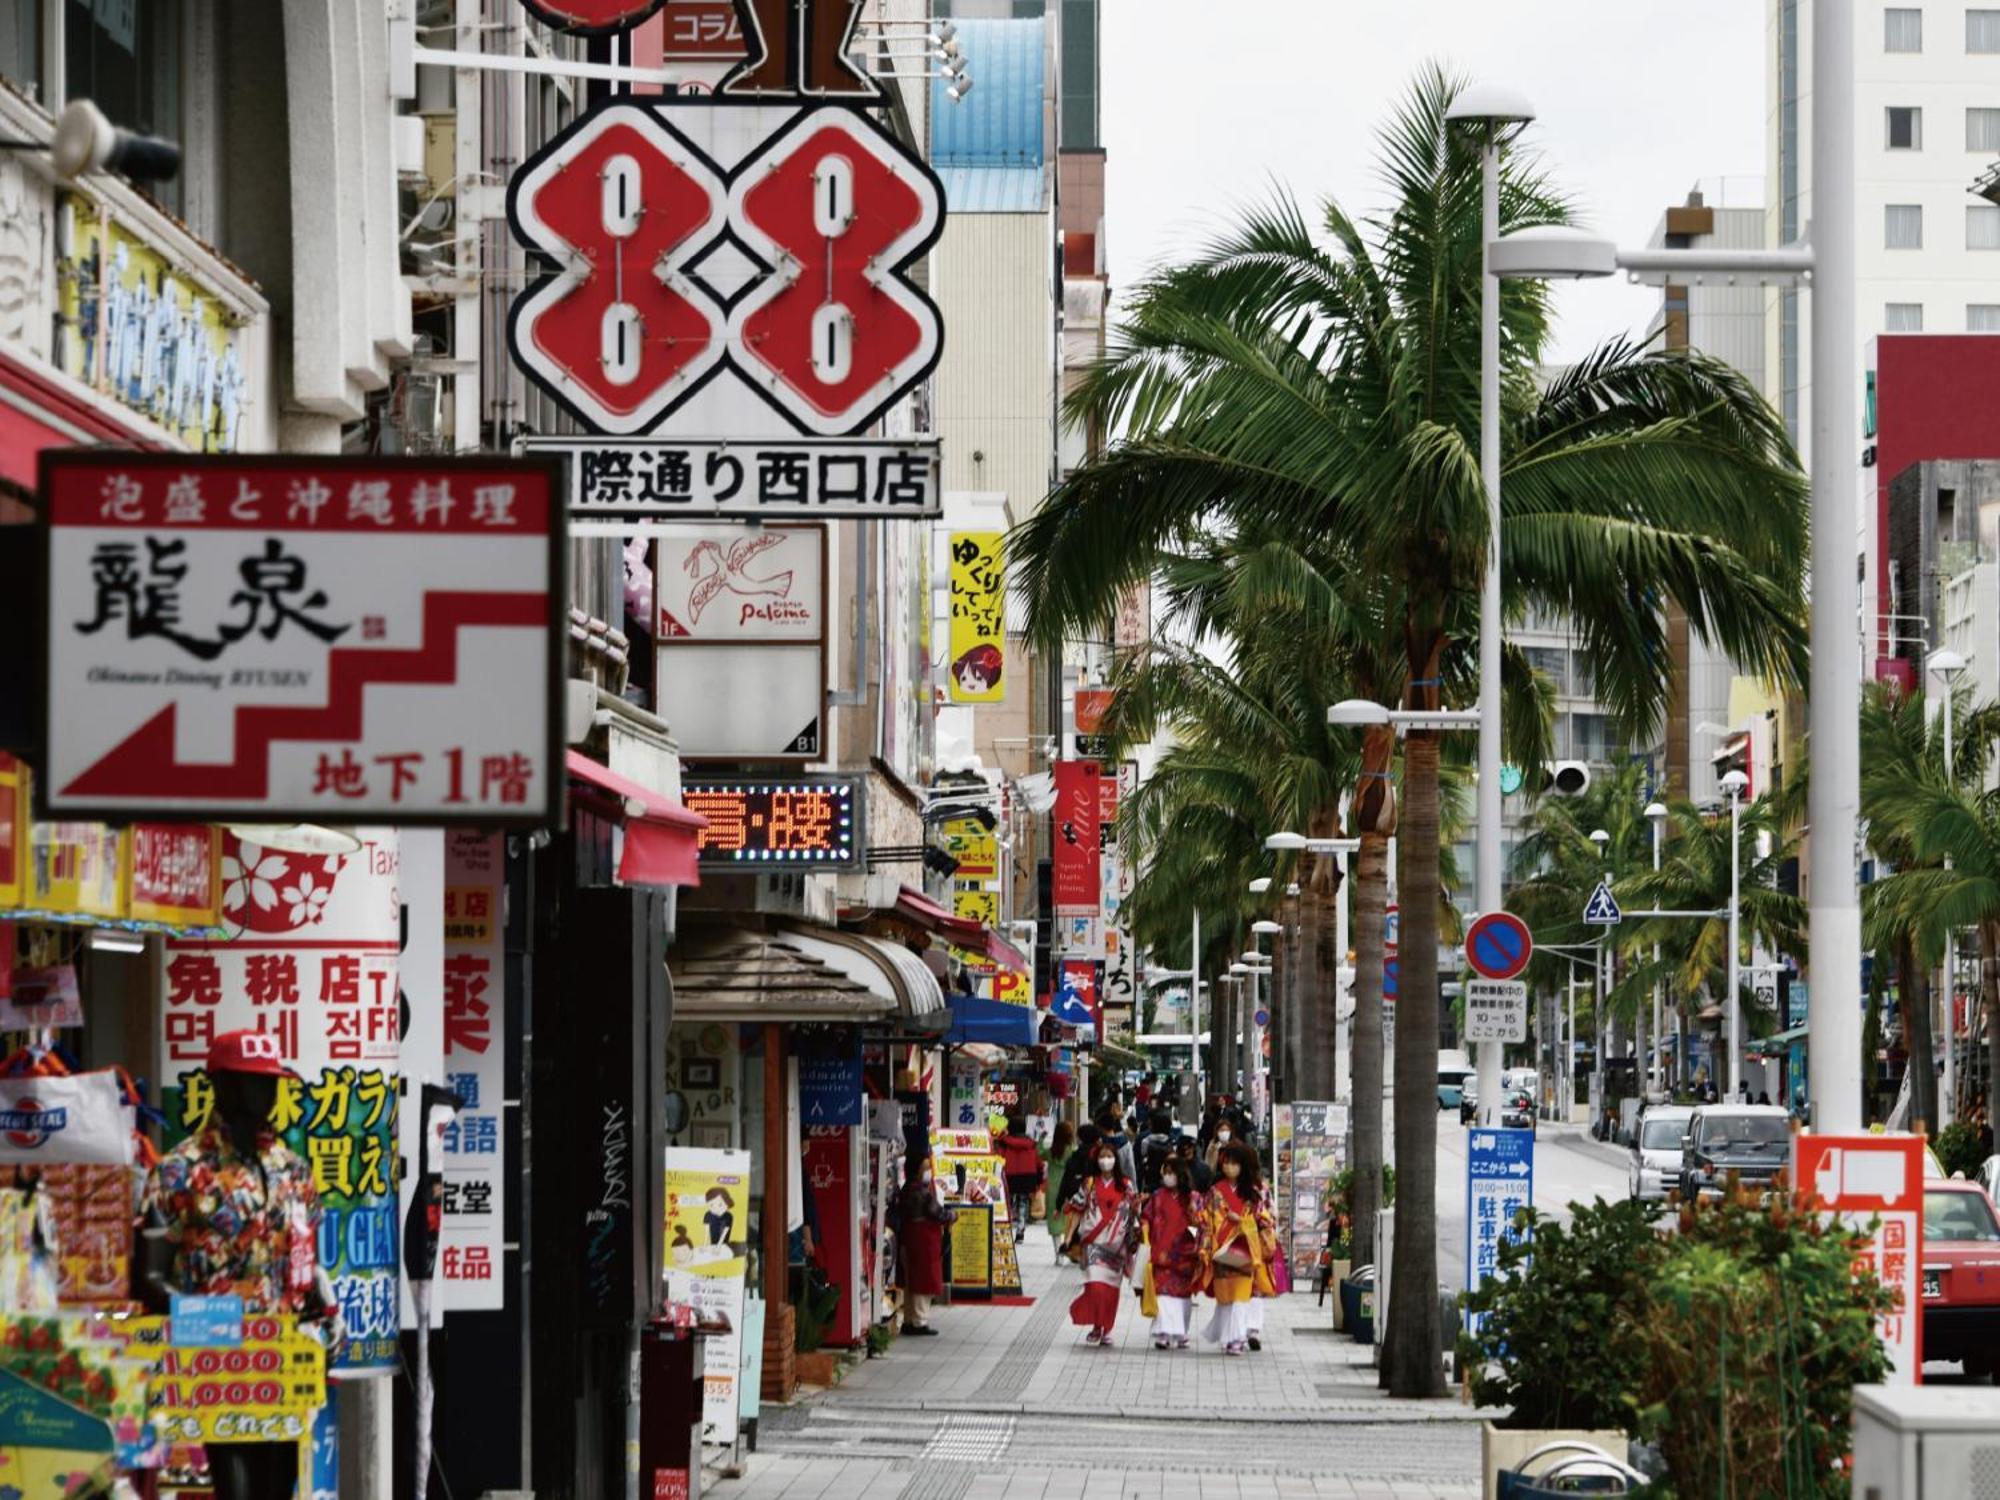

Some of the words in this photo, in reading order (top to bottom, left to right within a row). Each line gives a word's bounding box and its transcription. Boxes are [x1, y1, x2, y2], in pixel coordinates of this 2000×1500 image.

[101, 474, 517, 525] 泡盛と沖縄料理
[564, 449, 929, 504] 際通り西口店
[313, 747, 532, 804] 地下1階
[166, 954, 360, 1006] 免税店
[1471, 1161, 1508, 1175] ここから
